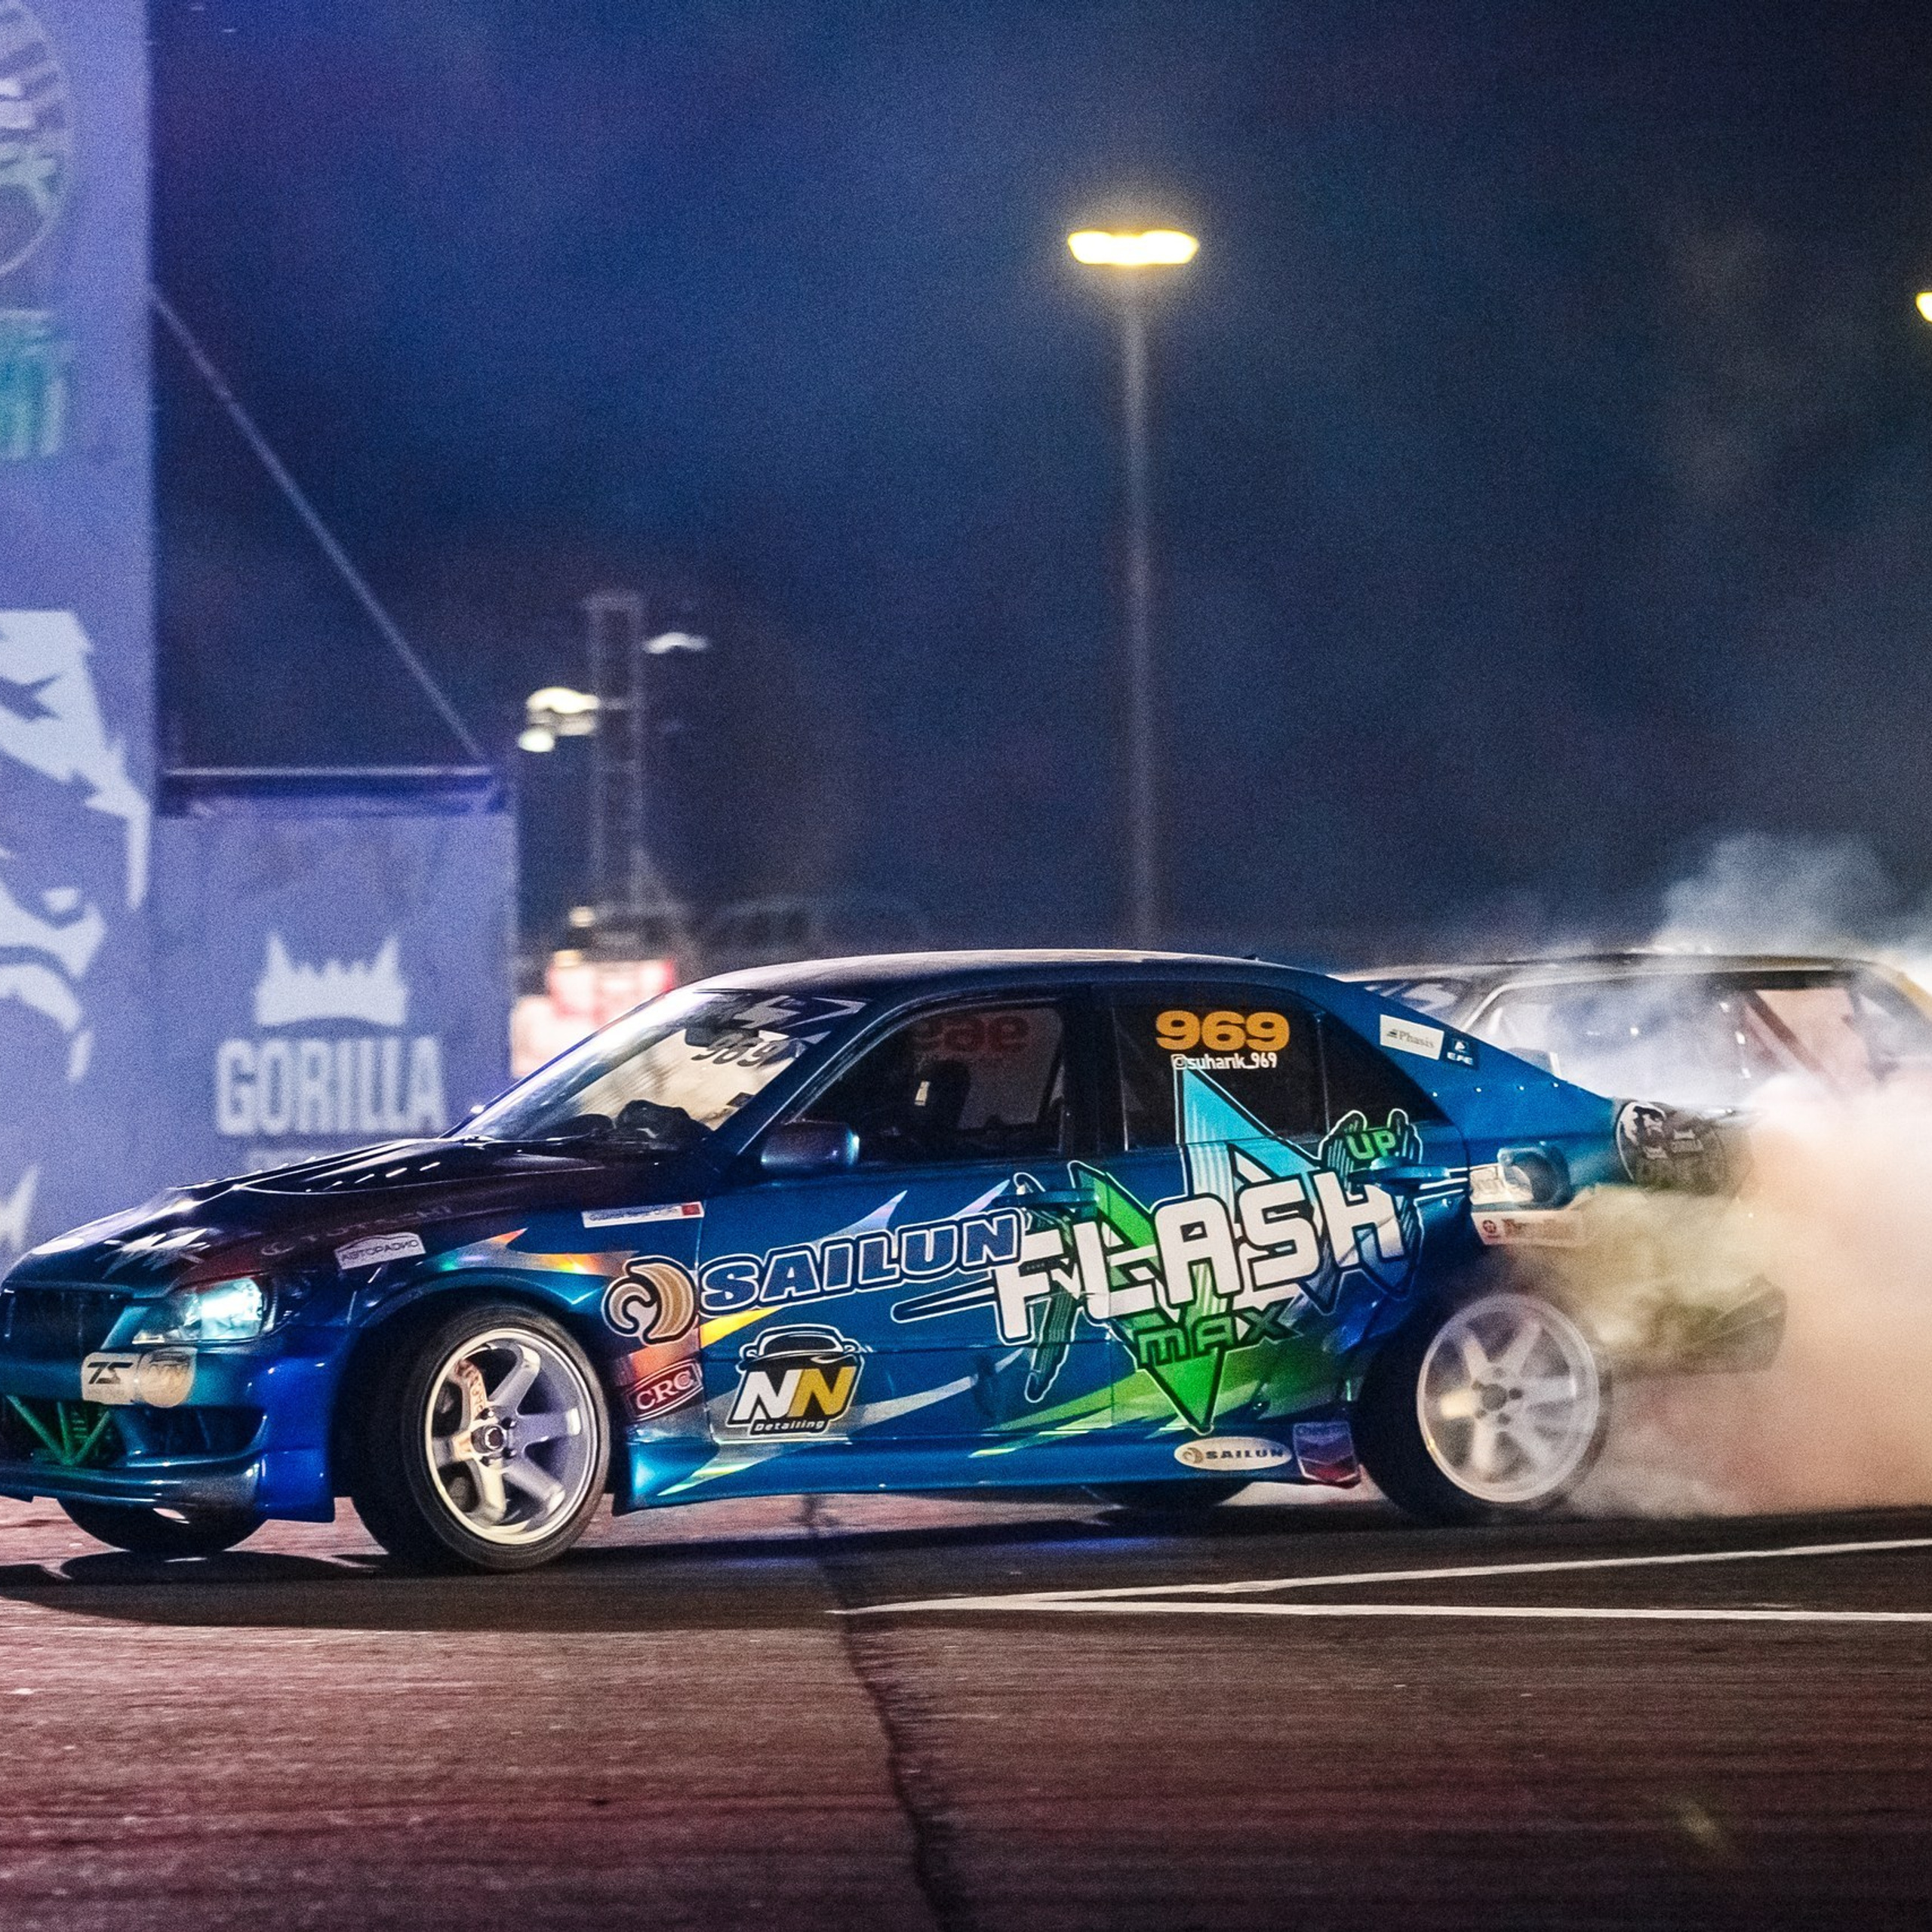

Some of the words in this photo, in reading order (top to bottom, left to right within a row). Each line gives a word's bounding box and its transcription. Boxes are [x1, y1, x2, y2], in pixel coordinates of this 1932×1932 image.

[1156, 1010, 1290, 1051] 969
[217, 1036, 446, 1132] GORILLA
[1346, 1131, 1396, 1159] UP
[697, 1208, 1025, 1319] SAILUN
[995, 1171, 1405, 1340] FLASH
[636, 1370, 694, 1410] CRC
[732, 1366, 857, 1420] NN
[1205, 1449, 1284, 1460] SAILUN
